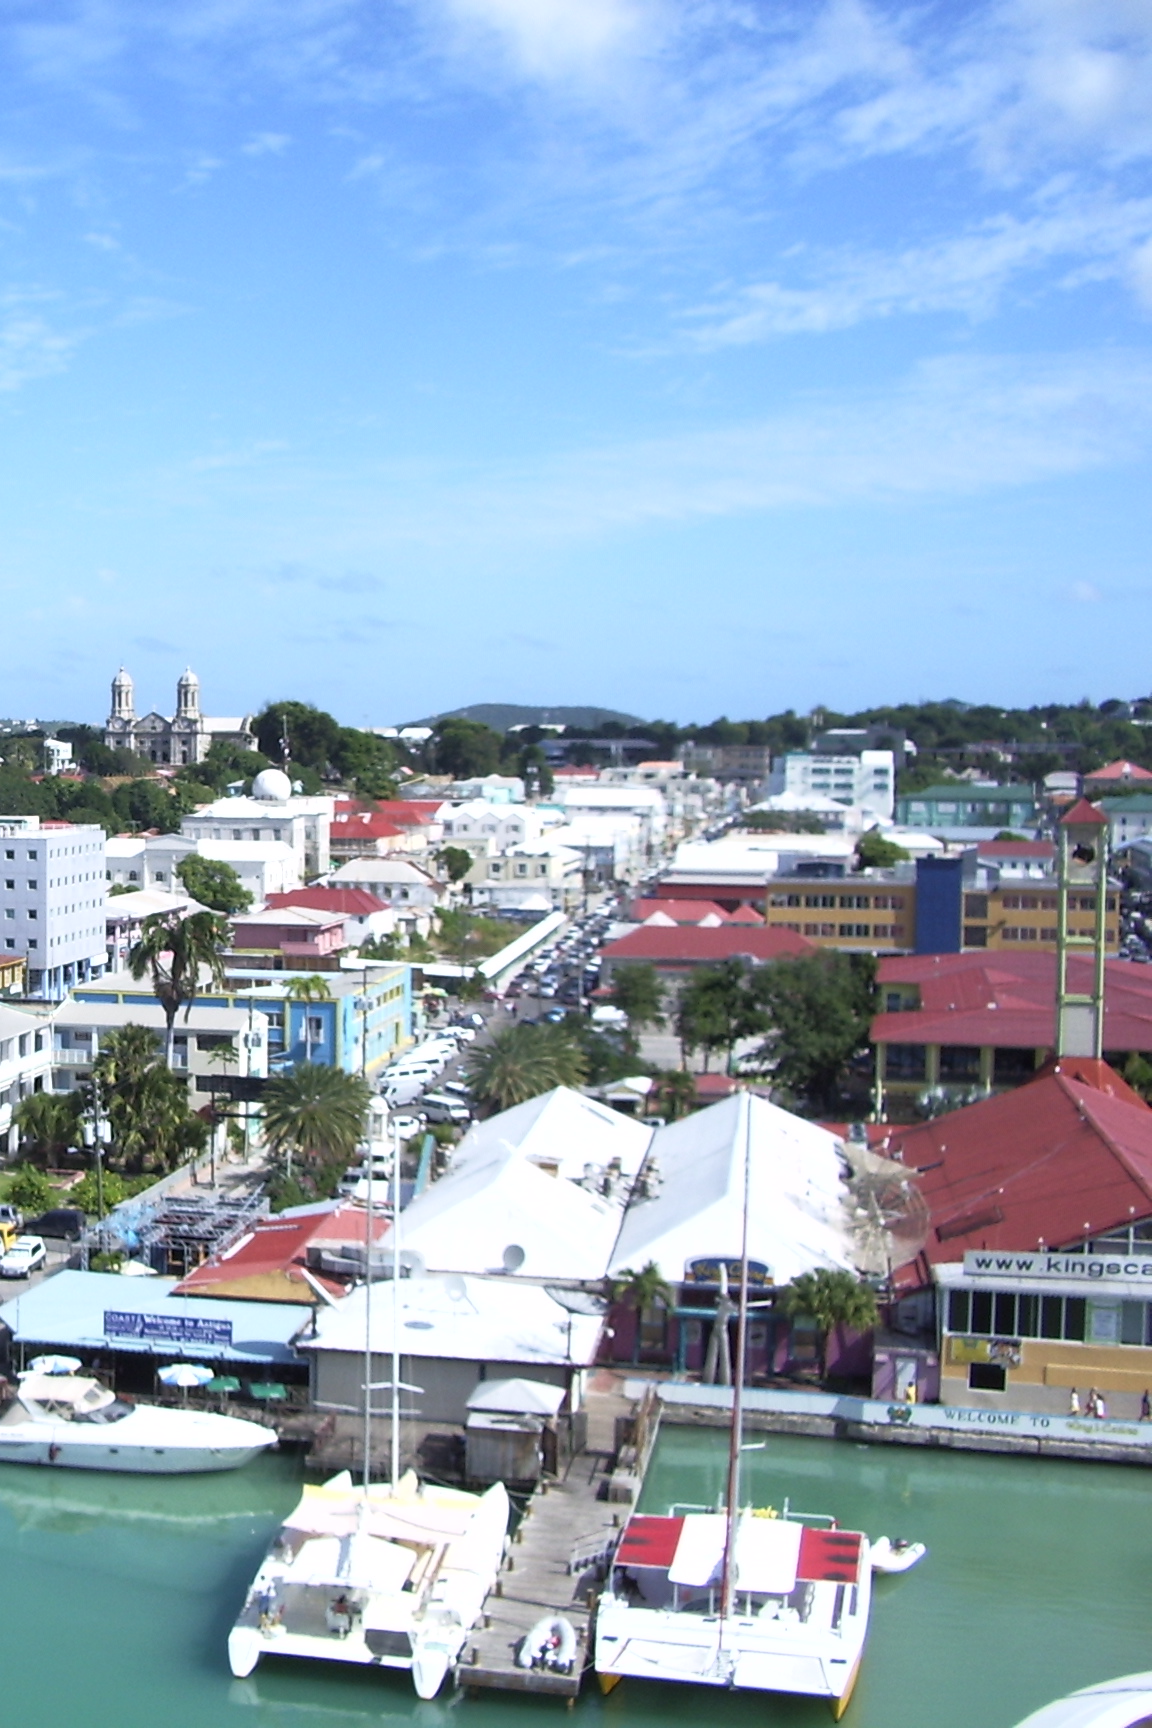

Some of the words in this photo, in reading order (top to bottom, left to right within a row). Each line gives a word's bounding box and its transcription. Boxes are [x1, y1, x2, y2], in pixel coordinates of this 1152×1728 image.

[144, 1314, 180, 1325] Welcome
[185, 1319, 194, 1327] to
[944, 1409, 1019, 1425] WELCOME
[1030, 1417, 1050, 1428] TO
